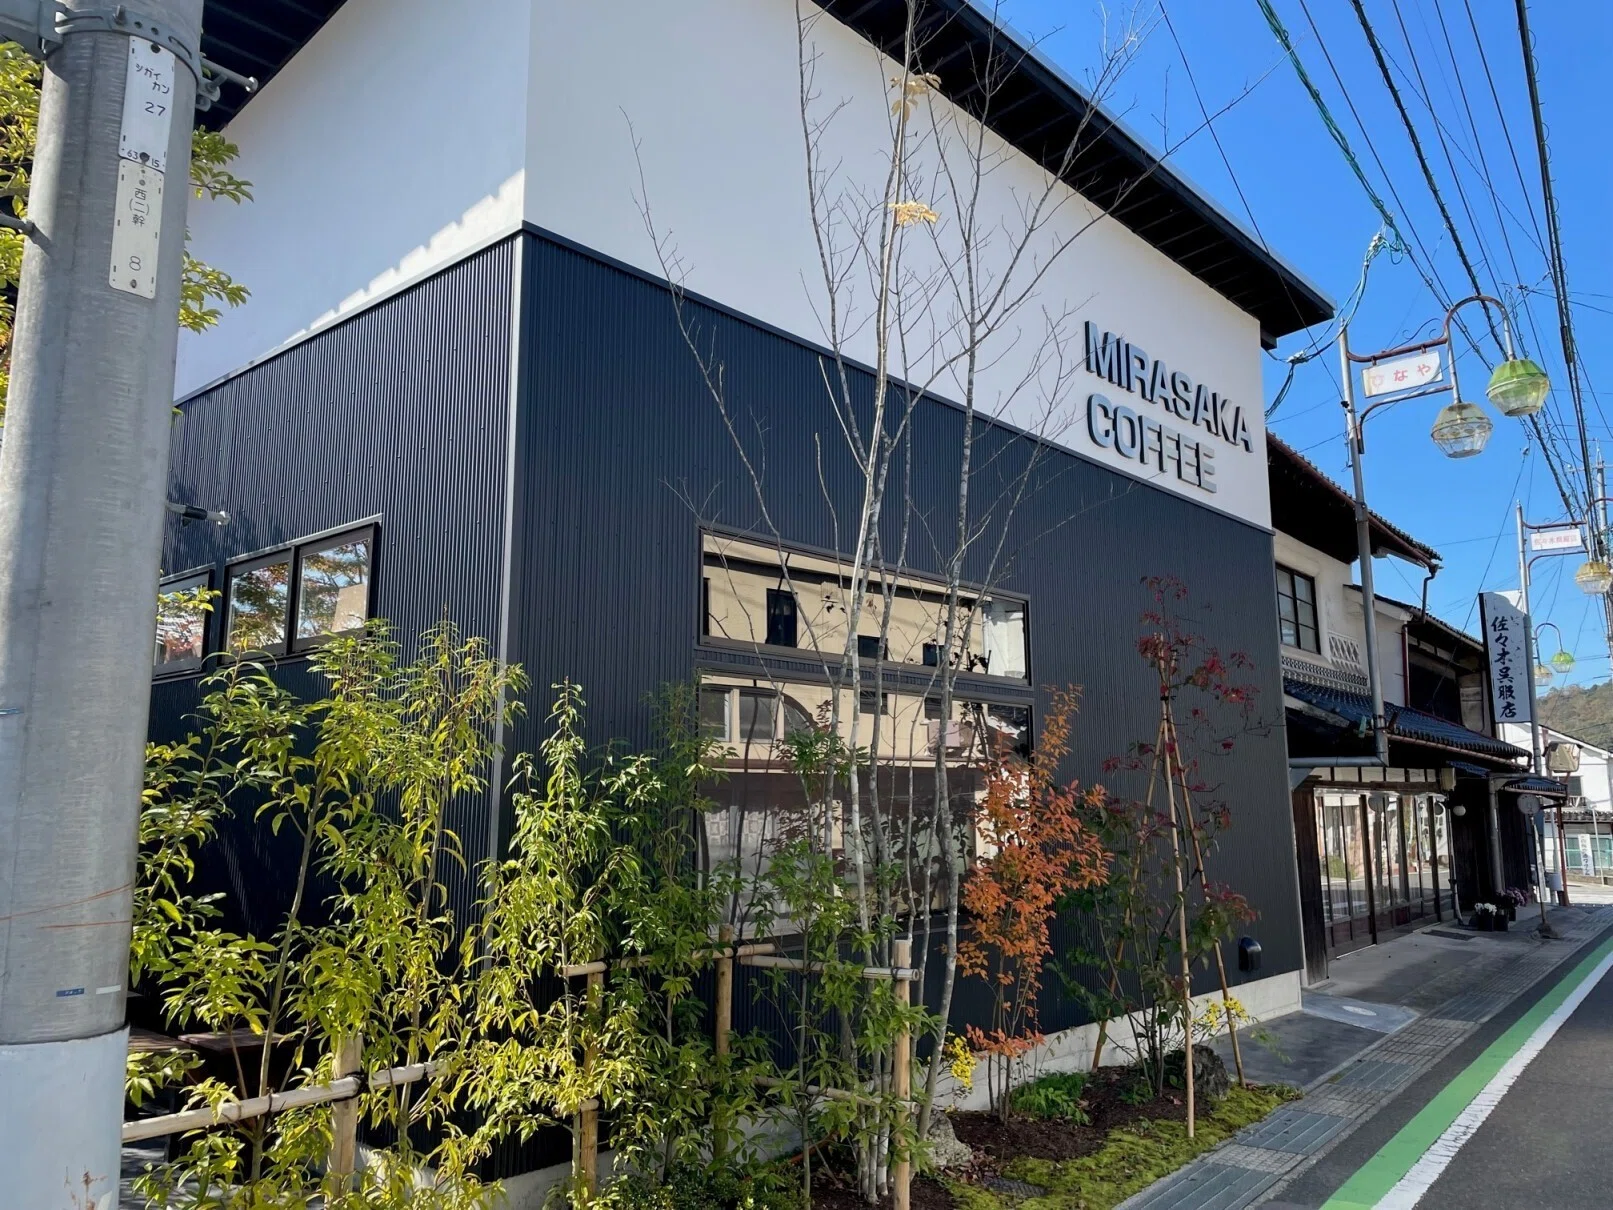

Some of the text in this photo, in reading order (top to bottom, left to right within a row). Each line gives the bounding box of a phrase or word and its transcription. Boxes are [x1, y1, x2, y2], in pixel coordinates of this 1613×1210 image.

[151, 81, 170, 94] カン
[144, 101, 167, 117] 27
[127, 149, 160, 168] 63 15
[129, 254, 142, 272] 8
[1085, 321, 1254, 453] MIRASAKA
[1087, 393, 1217, 493] COFFEE
[1491, 615, 1517, 719] 佐々木呉服店
